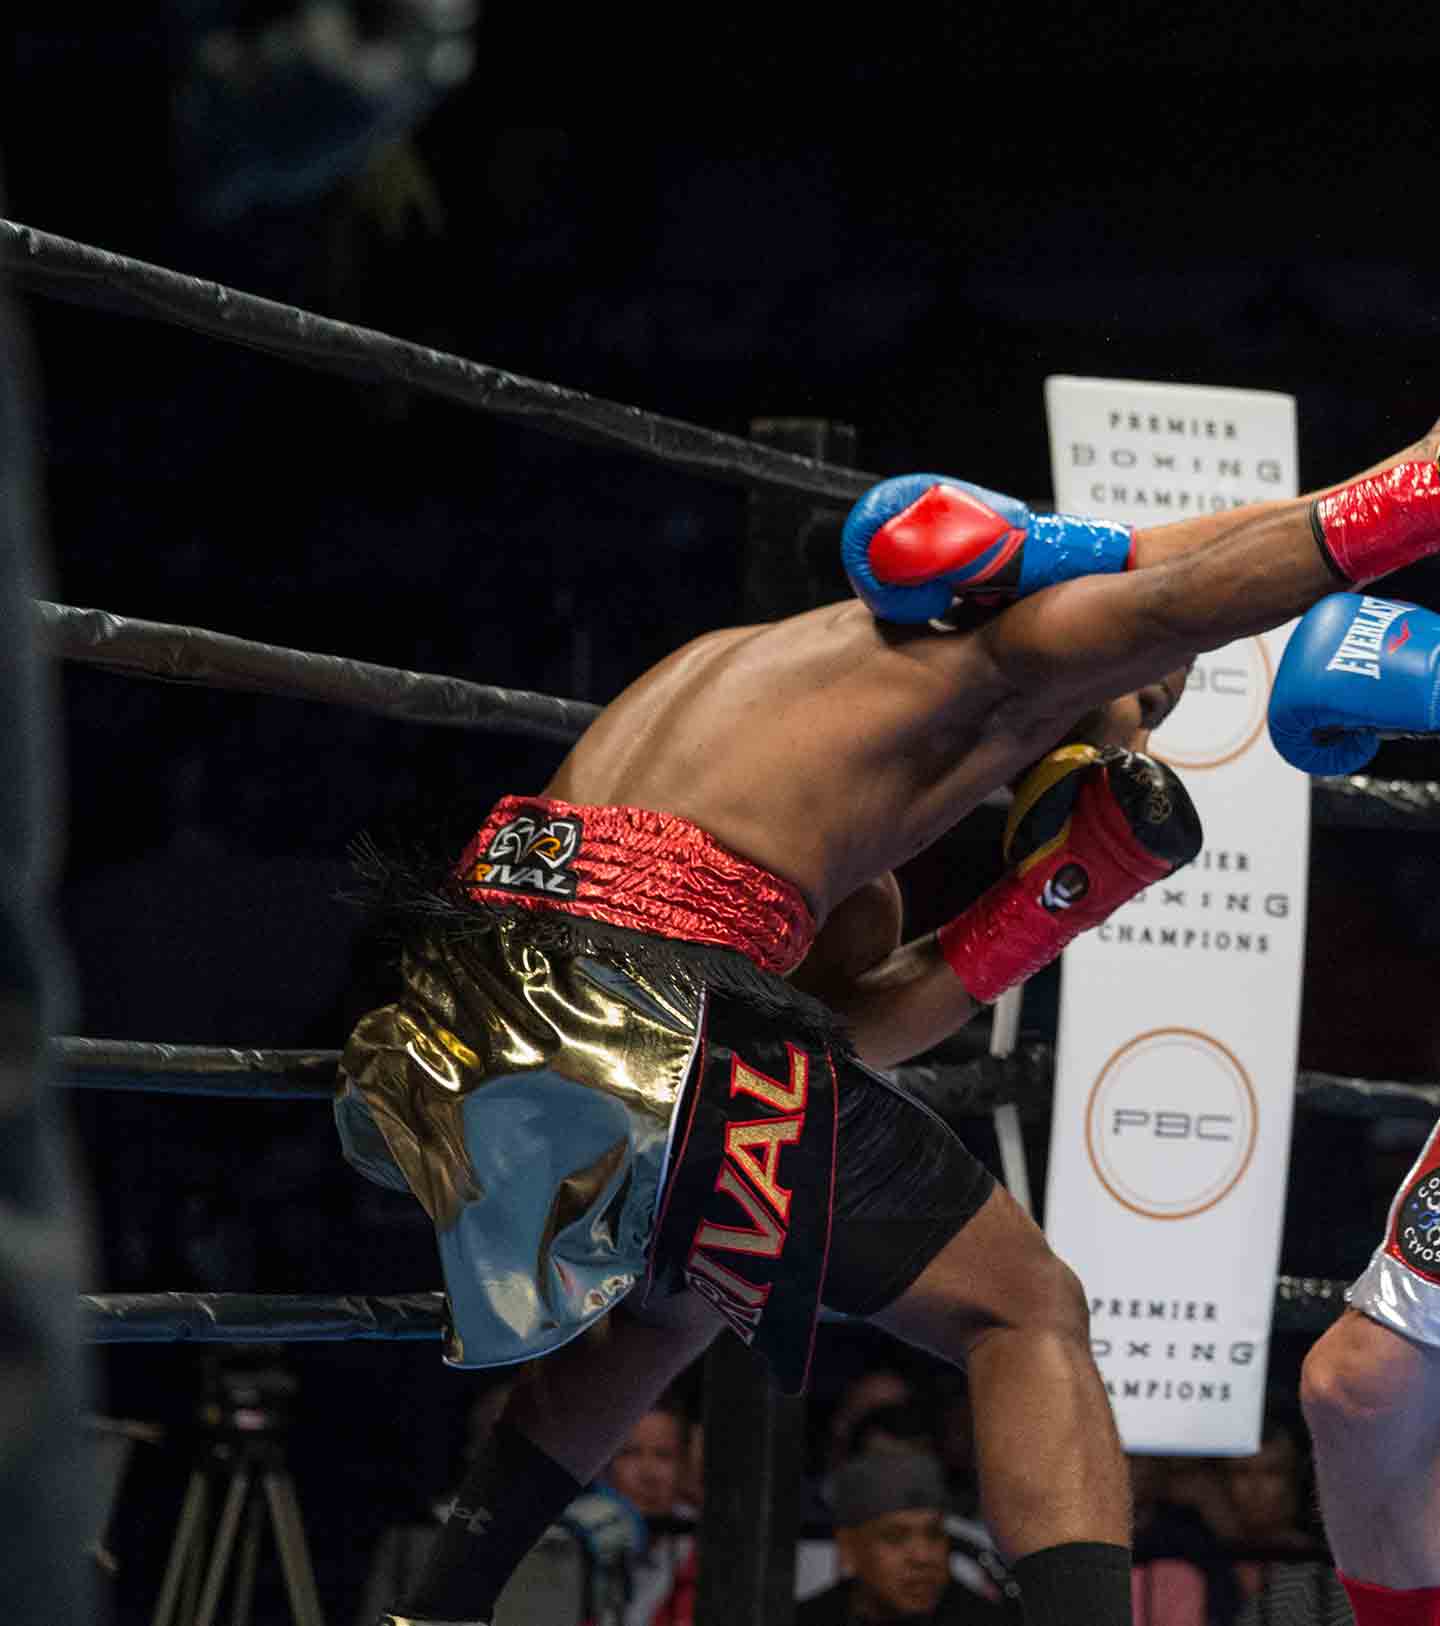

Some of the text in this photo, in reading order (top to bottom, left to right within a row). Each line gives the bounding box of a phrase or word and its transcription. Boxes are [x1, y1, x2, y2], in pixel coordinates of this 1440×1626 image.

[1109, 411, 1236, 438] PREMIER
[1071, 443, 1282, 483] BOXING
[1325, 596, 1414, 680] EVERLAS
[472, 863, 571, 894] RIVAL
[1135, 890, 1290, 918] XING
[1099, 924, 1270, 952] CHAMPIONS
[1112, 1109, 1233, 1141] PBC
[1092, 1299, 1217, 1320] PREMIER
[1090, 1339, 1254, 1365] OXING
[1104, 1380, 1232, 1402] AMPIONS
